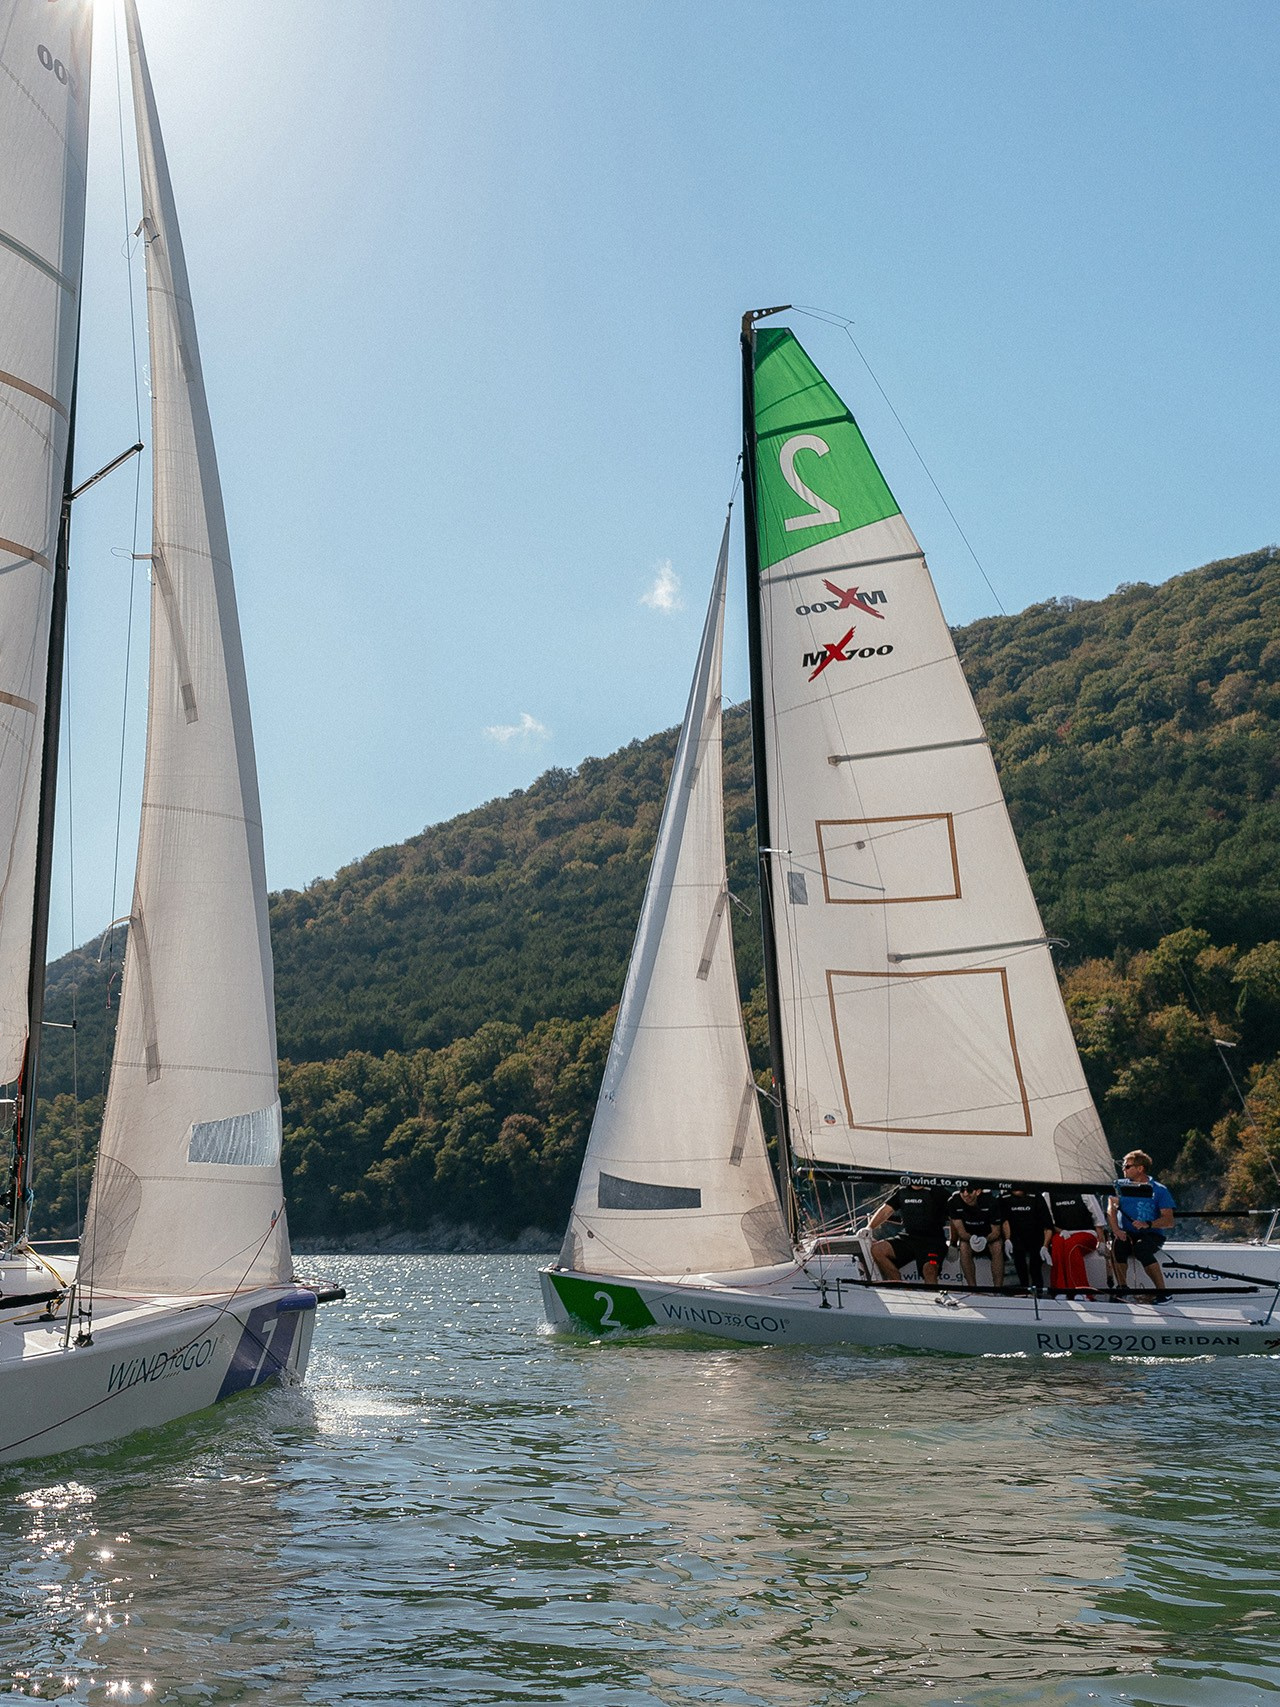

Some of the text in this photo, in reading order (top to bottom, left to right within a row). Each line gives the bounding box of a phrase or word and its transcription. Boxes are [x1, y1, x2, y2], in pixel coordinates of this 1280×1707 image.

[802, 626, 894, 682] MX700
[911, 1178, 969, 1187] wind_to_go
[593, 1290, 621, 1327] 2
[1036, 1333, 1240, 1351] RUS2920 ERIDAN
